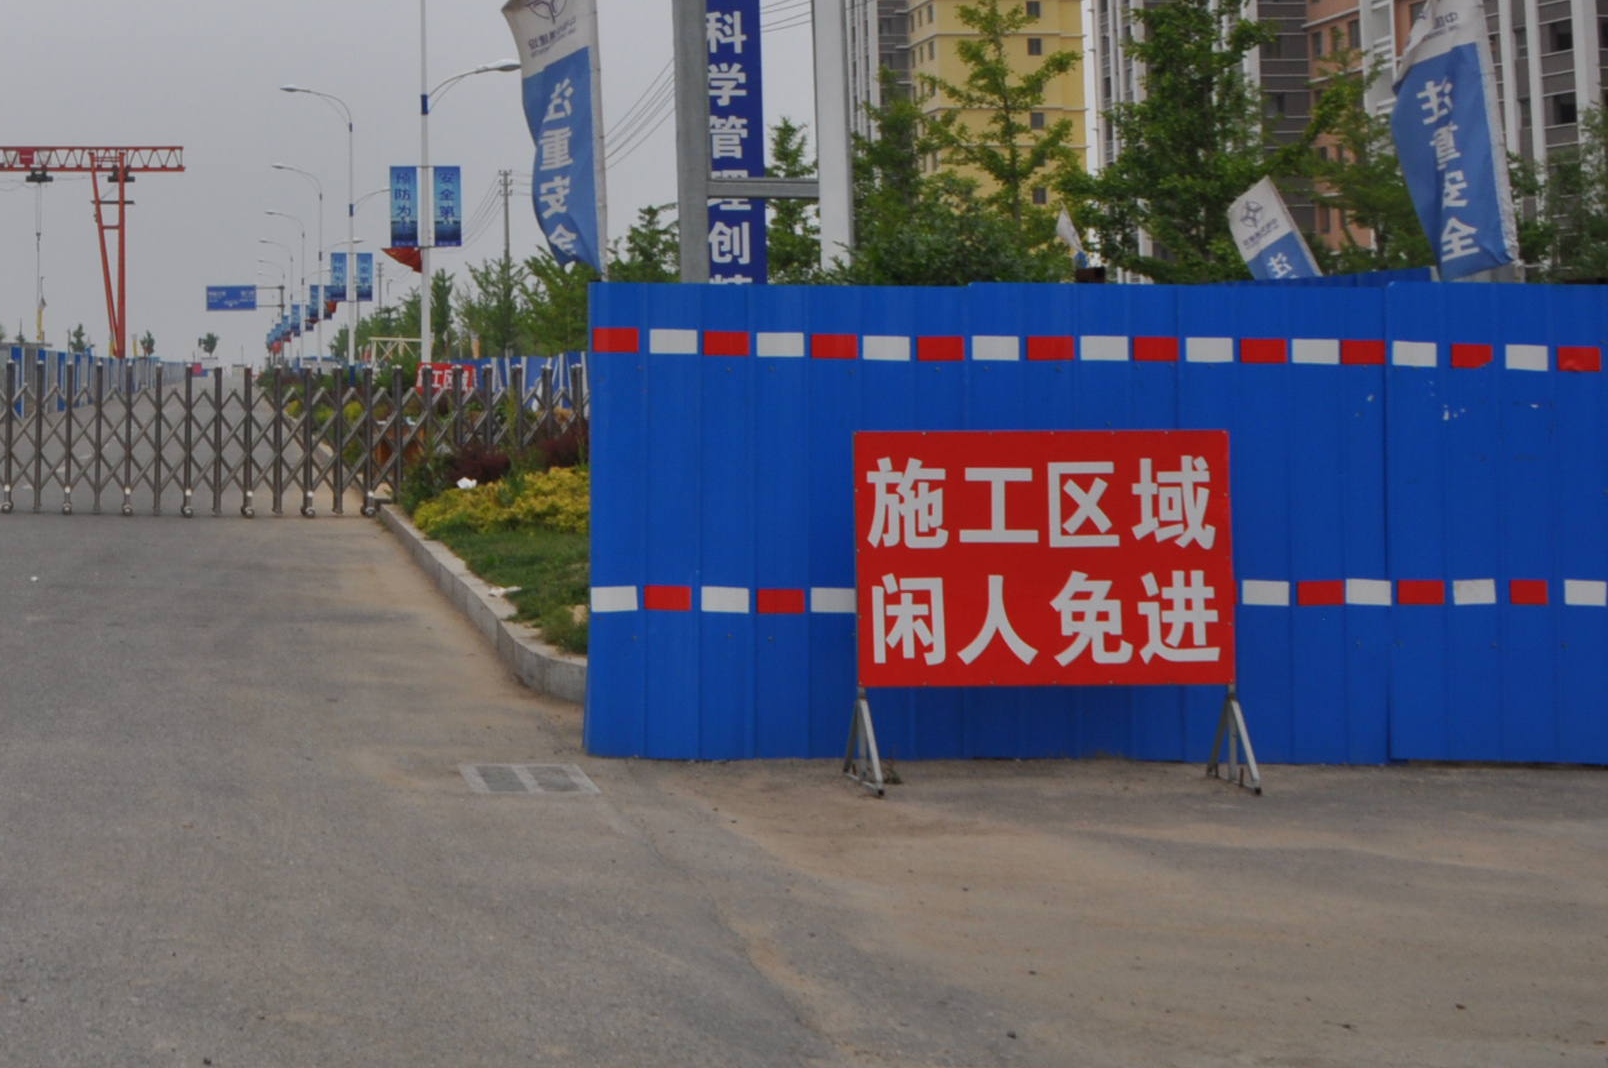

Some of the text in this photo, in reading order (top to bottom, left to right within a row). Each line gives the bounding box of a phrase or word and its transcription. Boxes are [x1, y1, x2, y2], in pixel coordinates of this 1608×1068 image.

[705, 10, 753, 284] 科学管创
[439, 172, 455, 228] 安全第
[866, 455, 1217, 550] 施工区域
[871, 569, 1221, 668] 闲人免进
